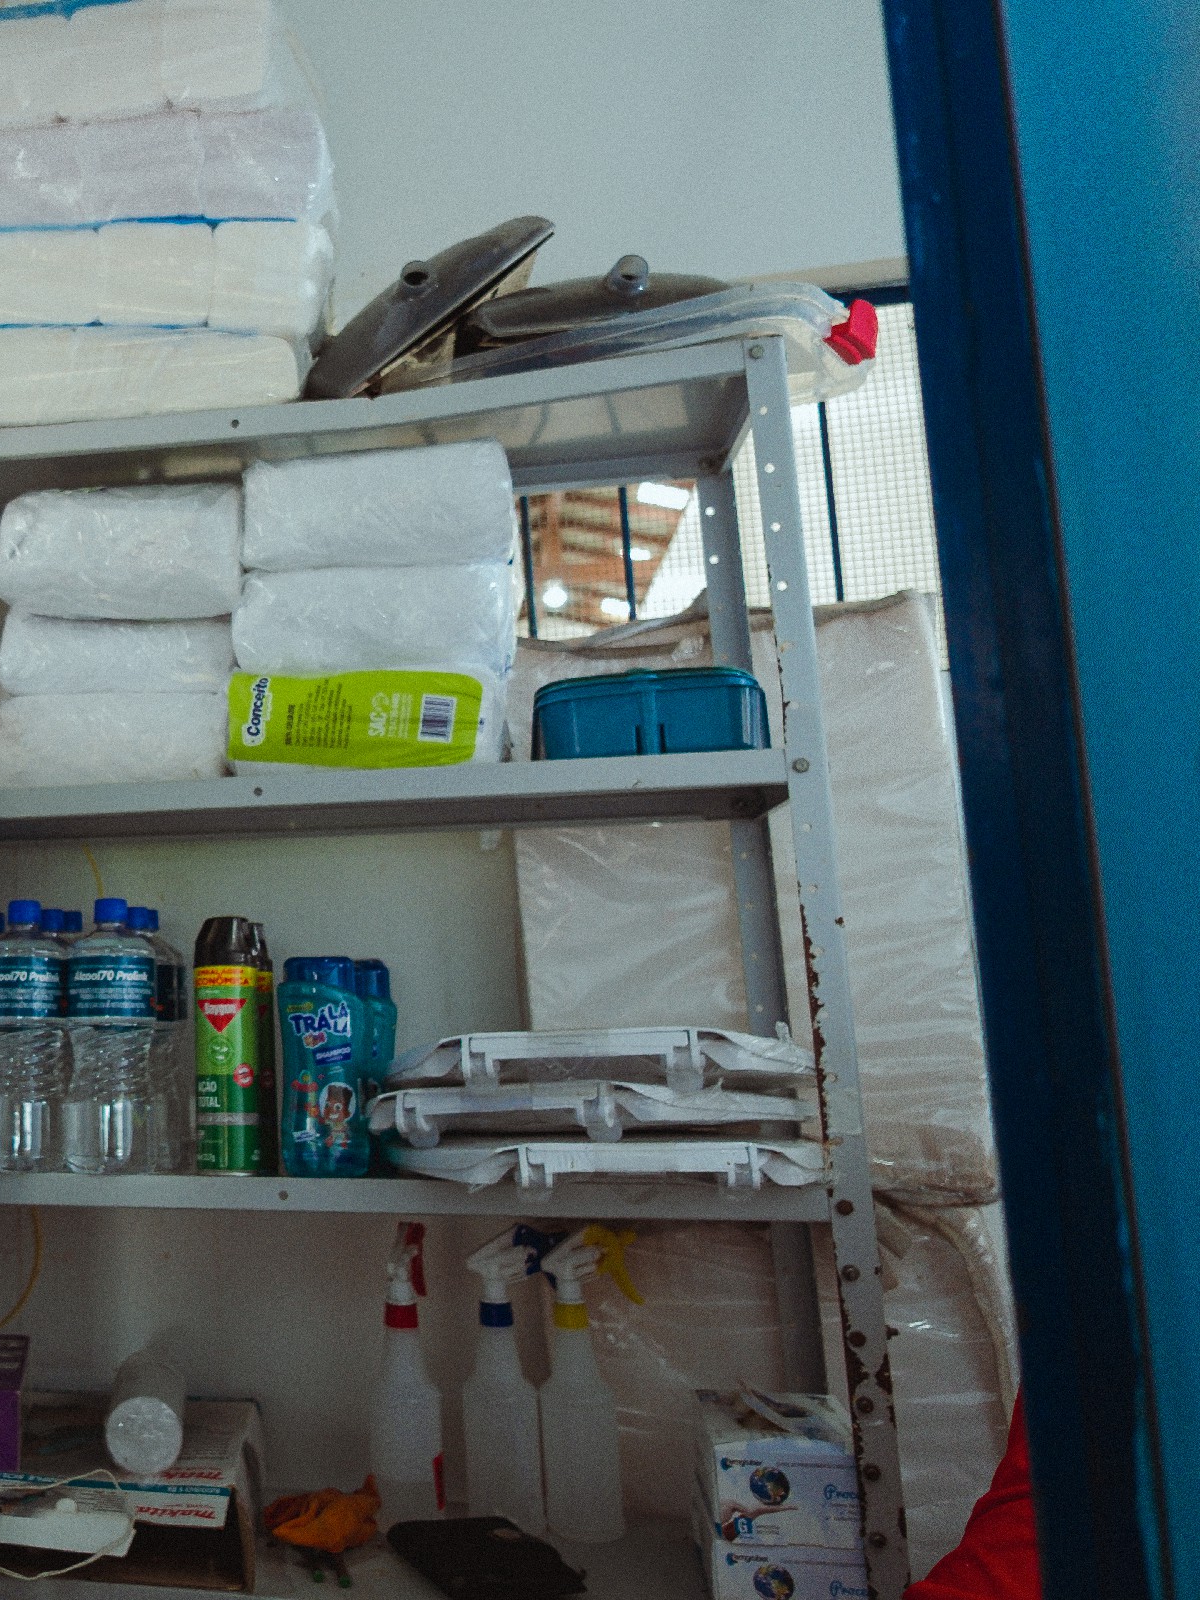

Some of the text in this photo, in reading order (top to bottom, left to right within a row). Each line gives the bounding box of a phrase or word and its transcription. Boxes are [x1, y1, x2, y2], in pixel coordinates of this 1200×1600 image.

[246, 676, 269, 738] Conceito
[367, 710, 388, 738] SAC
[135, 1504, 217, 1520] makita
